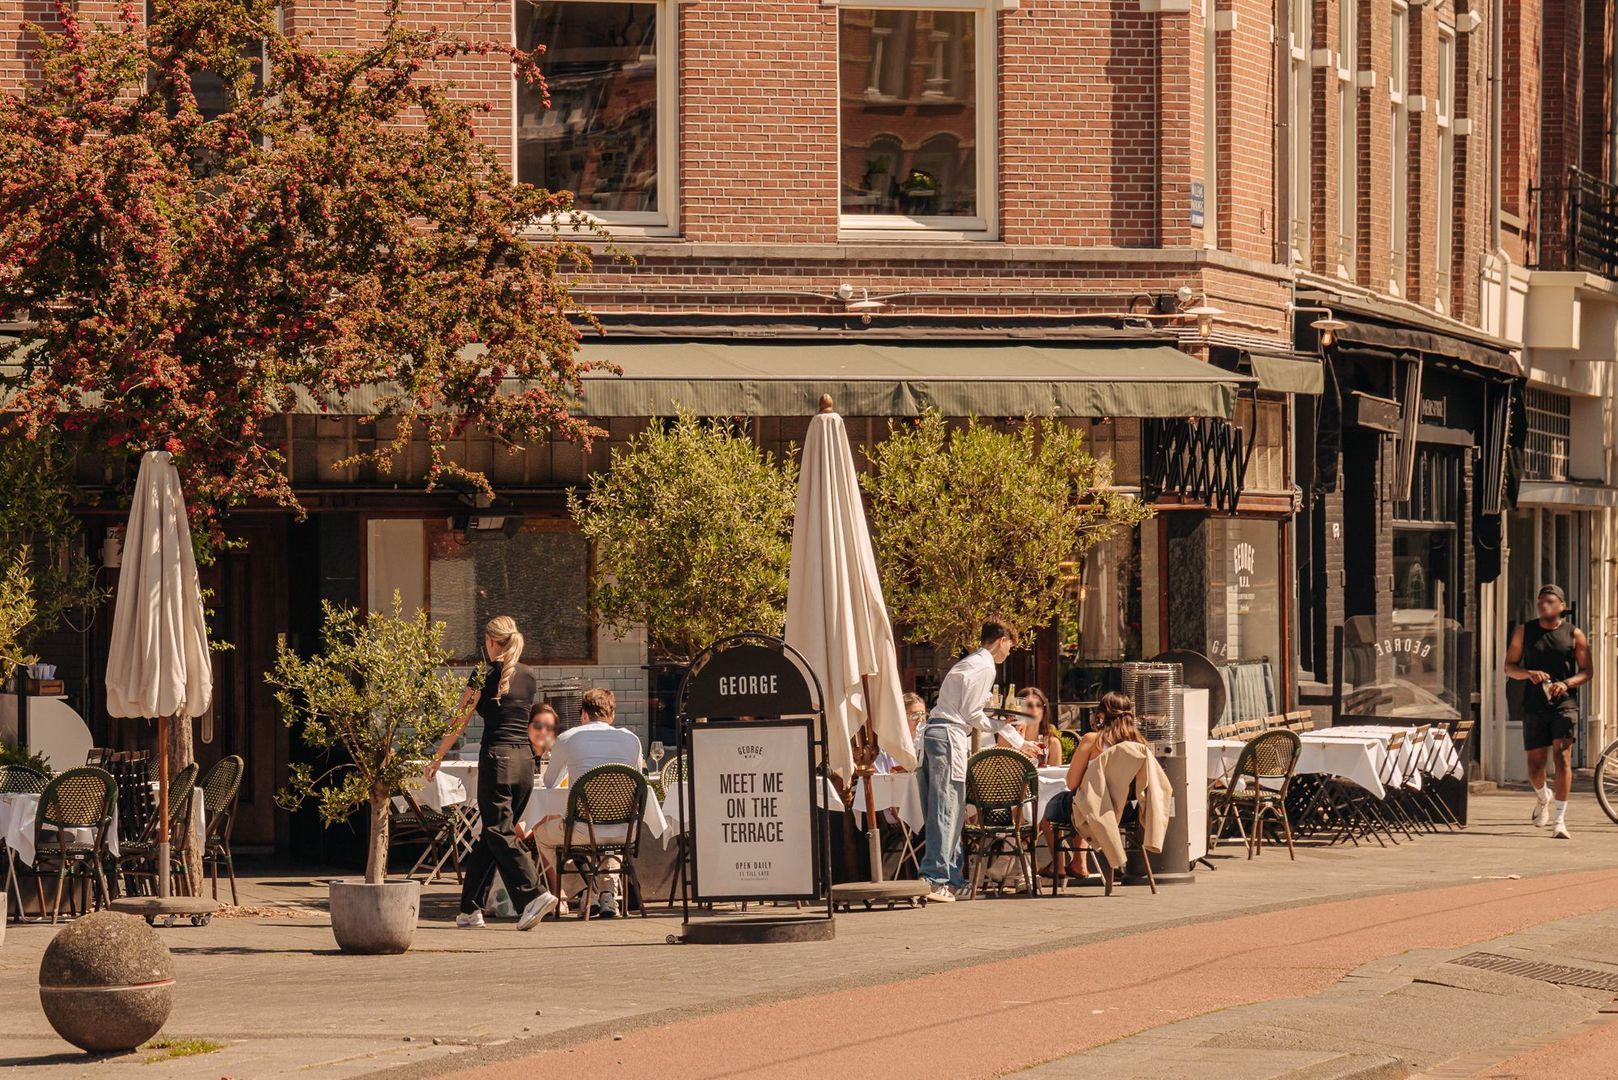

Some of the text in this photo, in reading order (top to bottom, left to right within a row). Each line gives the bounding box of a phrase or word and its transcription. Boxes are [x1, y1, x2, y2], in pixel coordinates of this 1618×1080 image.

[719, 674, 778, 696] GEORGE
[737, 745, 764, 756] GEORGE
[720, 773, 784, 794] MEET ME
[727, 797, 778, 818] ON THE
[721, 821, 784, 843] TERRACE
[735, 861, 772, 870] OPEN DAILY
